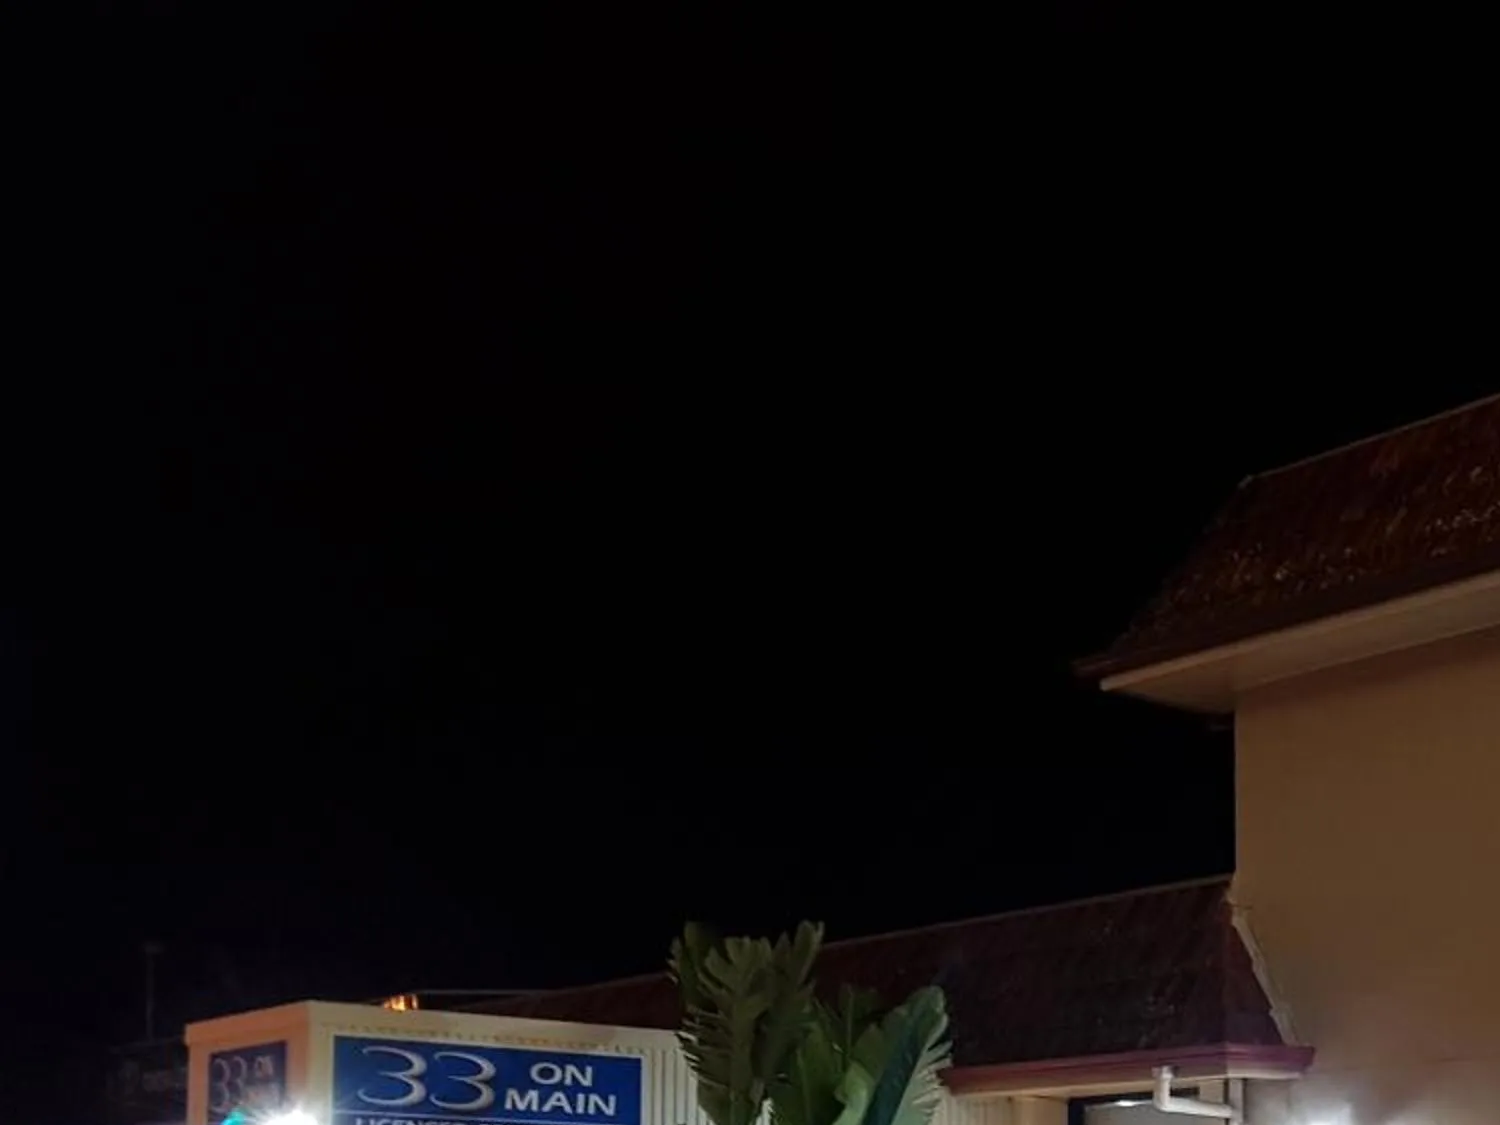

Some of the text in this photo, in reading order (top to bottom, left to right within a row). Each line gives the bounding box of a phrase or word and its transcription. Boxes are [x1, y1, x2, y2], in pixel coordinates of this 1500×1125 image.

[356, 1045, 497, 1112] 33
[530, 1061, 594, 1088] ON
[504, 1087, 618, 1117] MAIN
